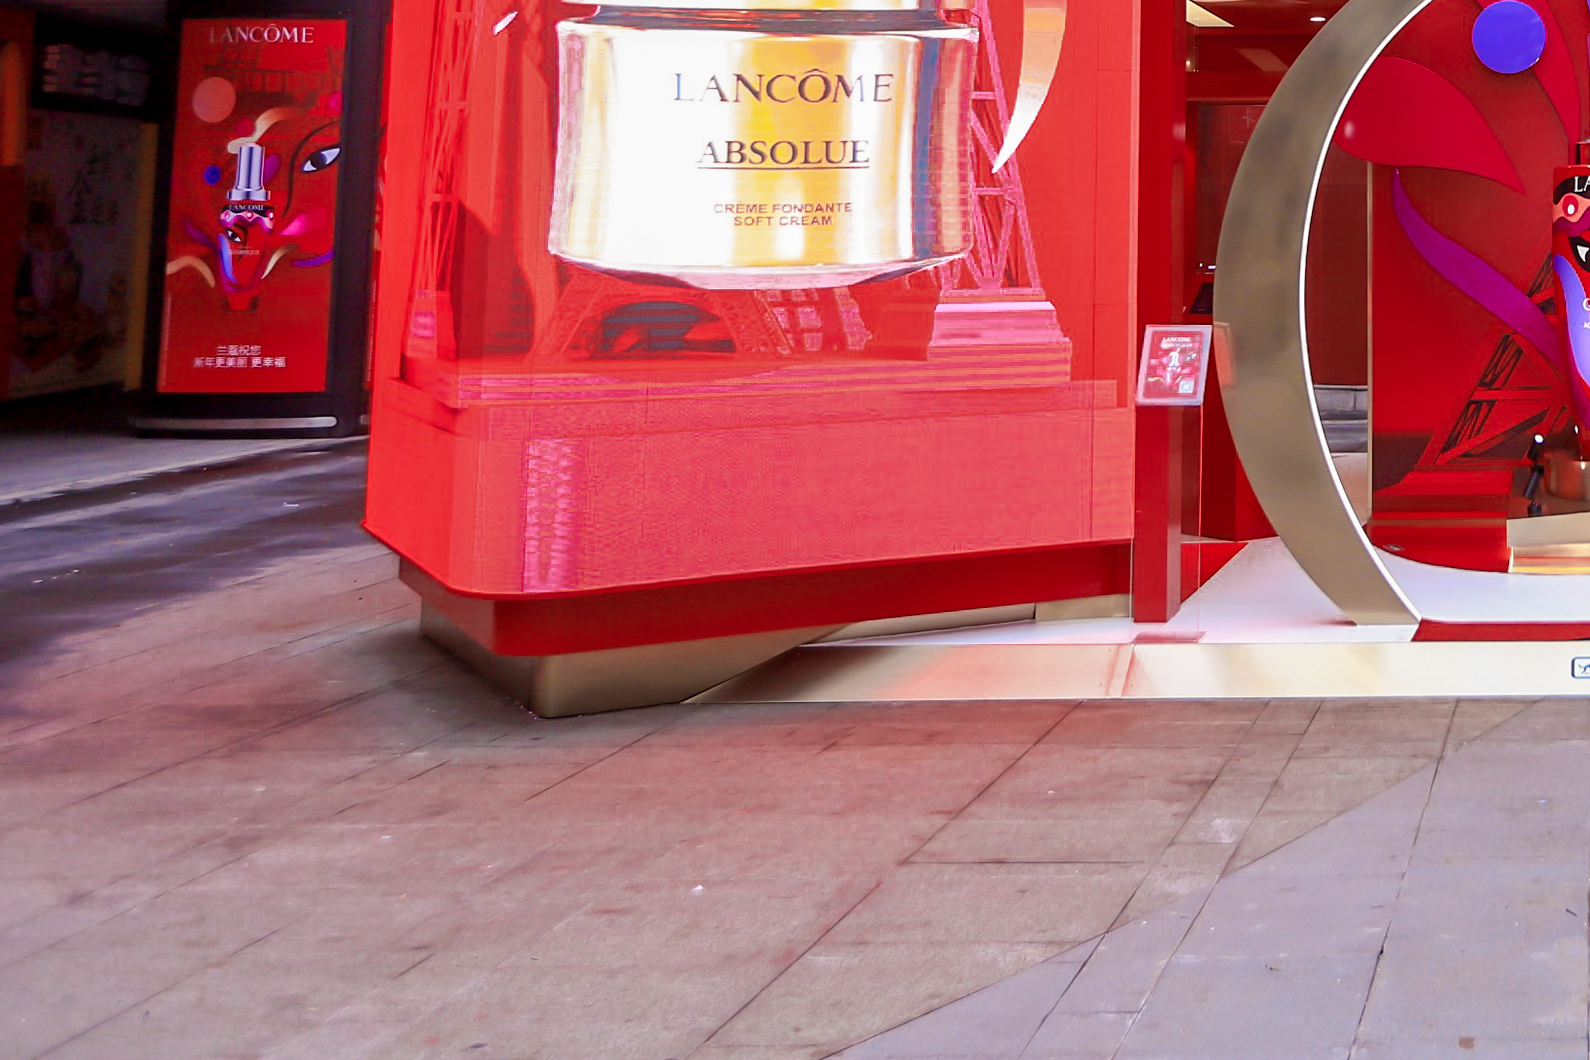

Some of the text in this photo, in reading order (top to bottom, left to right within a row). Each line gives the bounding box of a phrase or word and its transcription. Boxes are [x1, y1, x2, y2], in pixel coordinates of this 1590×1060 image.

[209, 23, 315, 44] LANCÔME
[673, 68, 894, 103] LANCÔME
[696, 140, 870, 165] ABSOLUE
[772, 202, 852, 213] FONDANTE
[733, 216, 833, 227] SOFT CREAM
[250, 356, 287, 368] 更幸福
